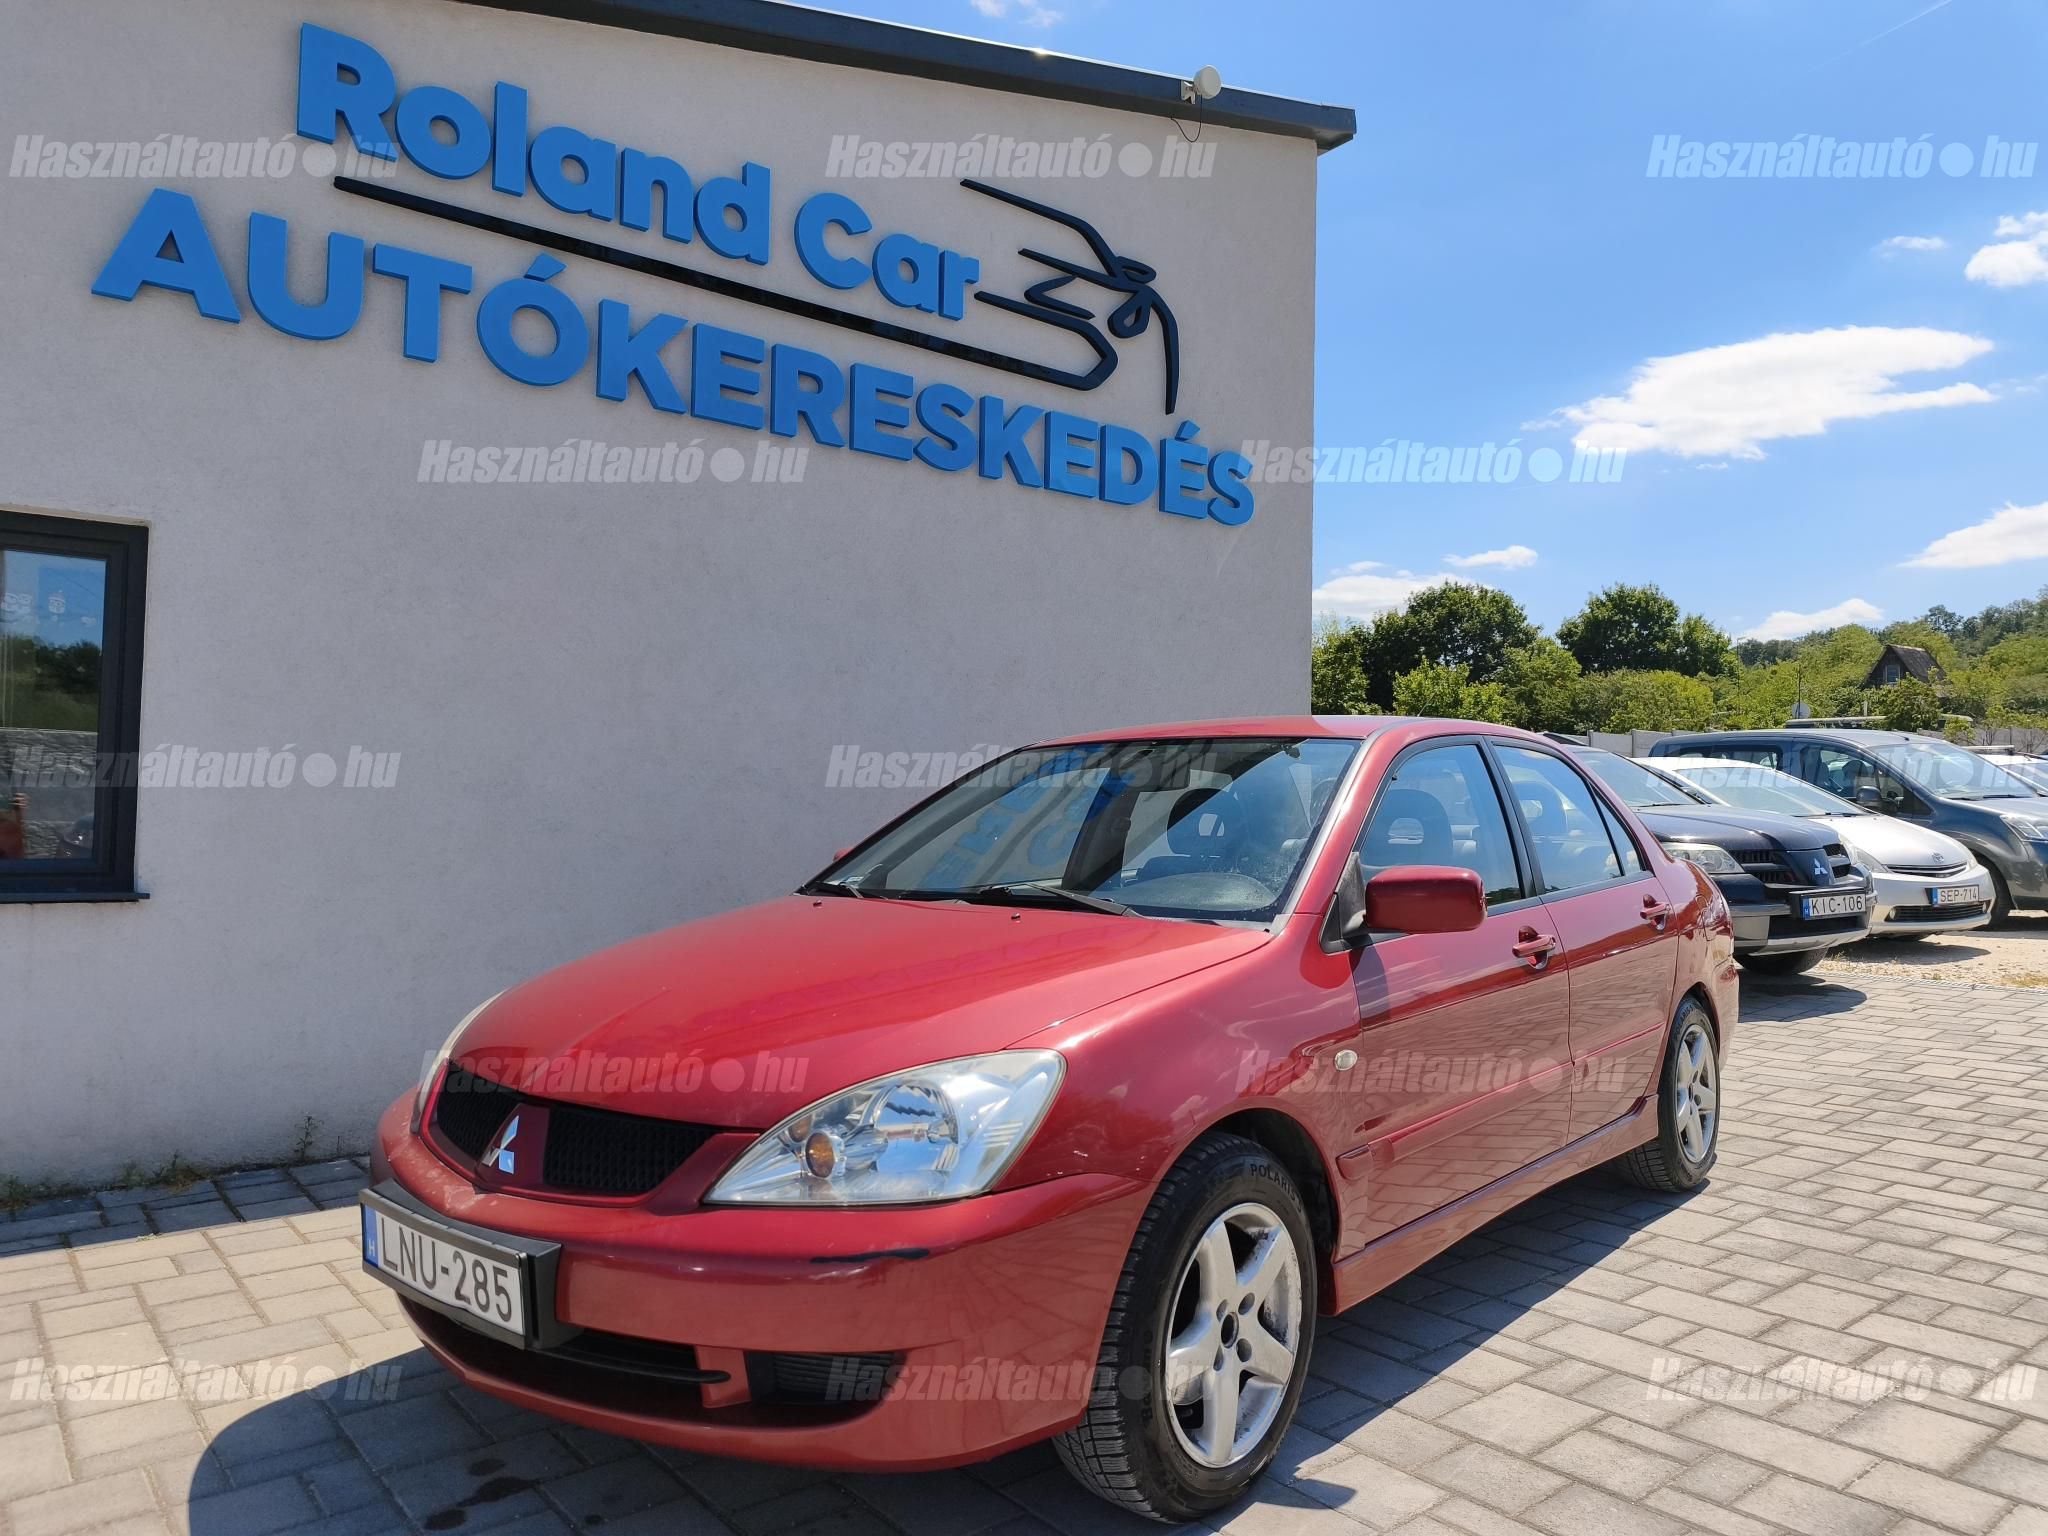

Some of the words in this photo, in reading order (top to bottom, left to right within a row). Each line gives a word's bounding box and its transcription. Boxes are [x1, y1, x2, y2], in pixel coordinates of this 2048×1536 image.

[297, 22, 770, 266] Roland
[794, 192, 979, 320] Car
[91, 188, 1255, 527] AUTÓKERESKEDÉS
[1811, 895, 1863, 916] KIC-106
[1939, 887, 1978, 904] SEP-714
[381, 1217, 513, 1323] LNU-285
